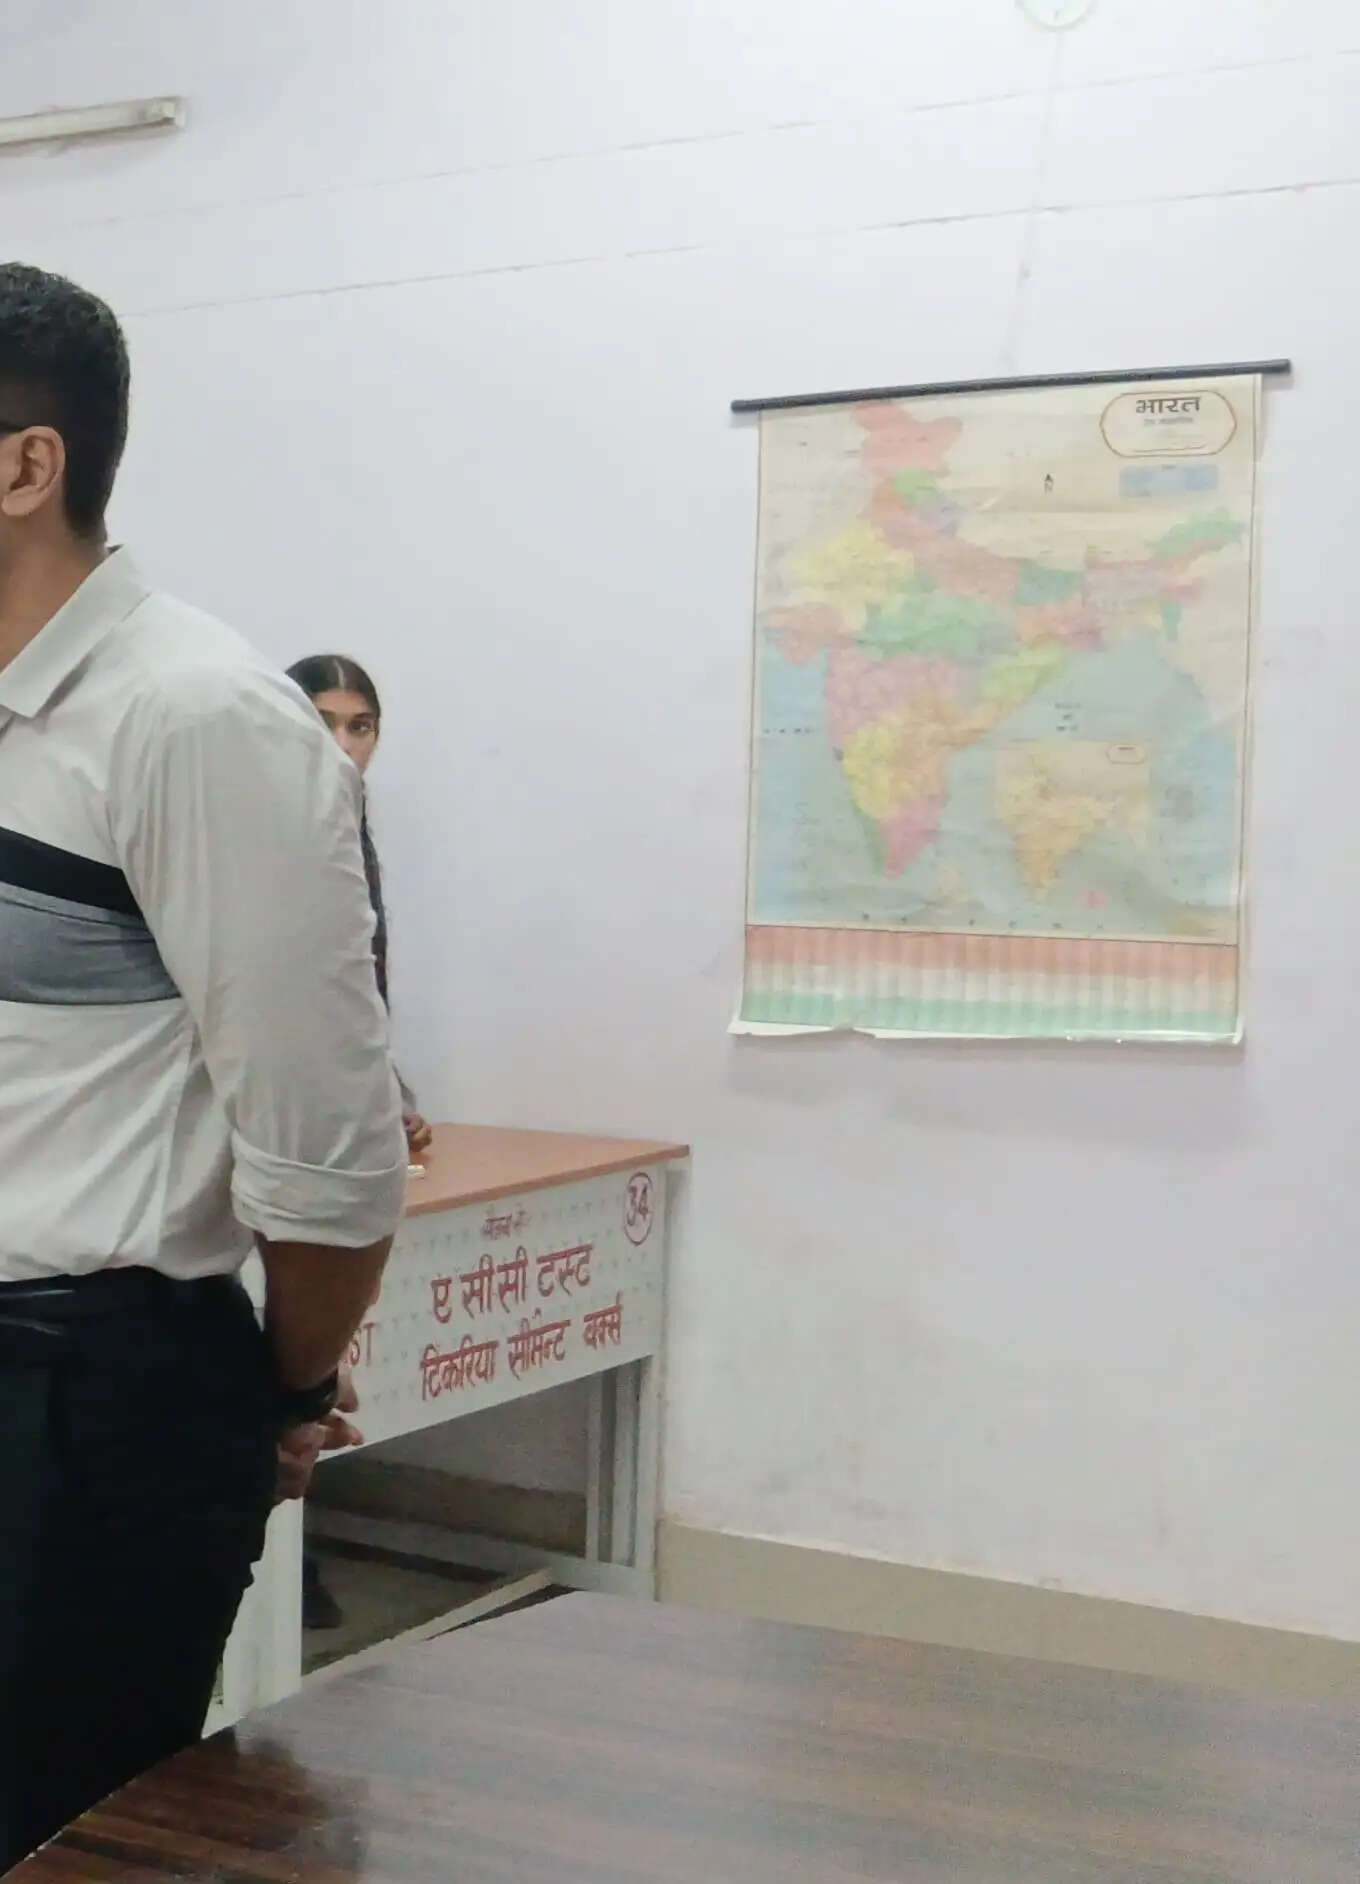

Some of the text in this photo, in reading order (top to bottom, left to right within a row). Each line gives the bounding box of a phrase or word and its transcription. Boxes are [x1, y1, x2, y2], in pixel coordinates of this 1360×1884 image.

[1135, 396, 1202, 415] भारत
[626, 1183, 651, 1227] 34
[419, 1333, 500, 1401] टिकरिया
